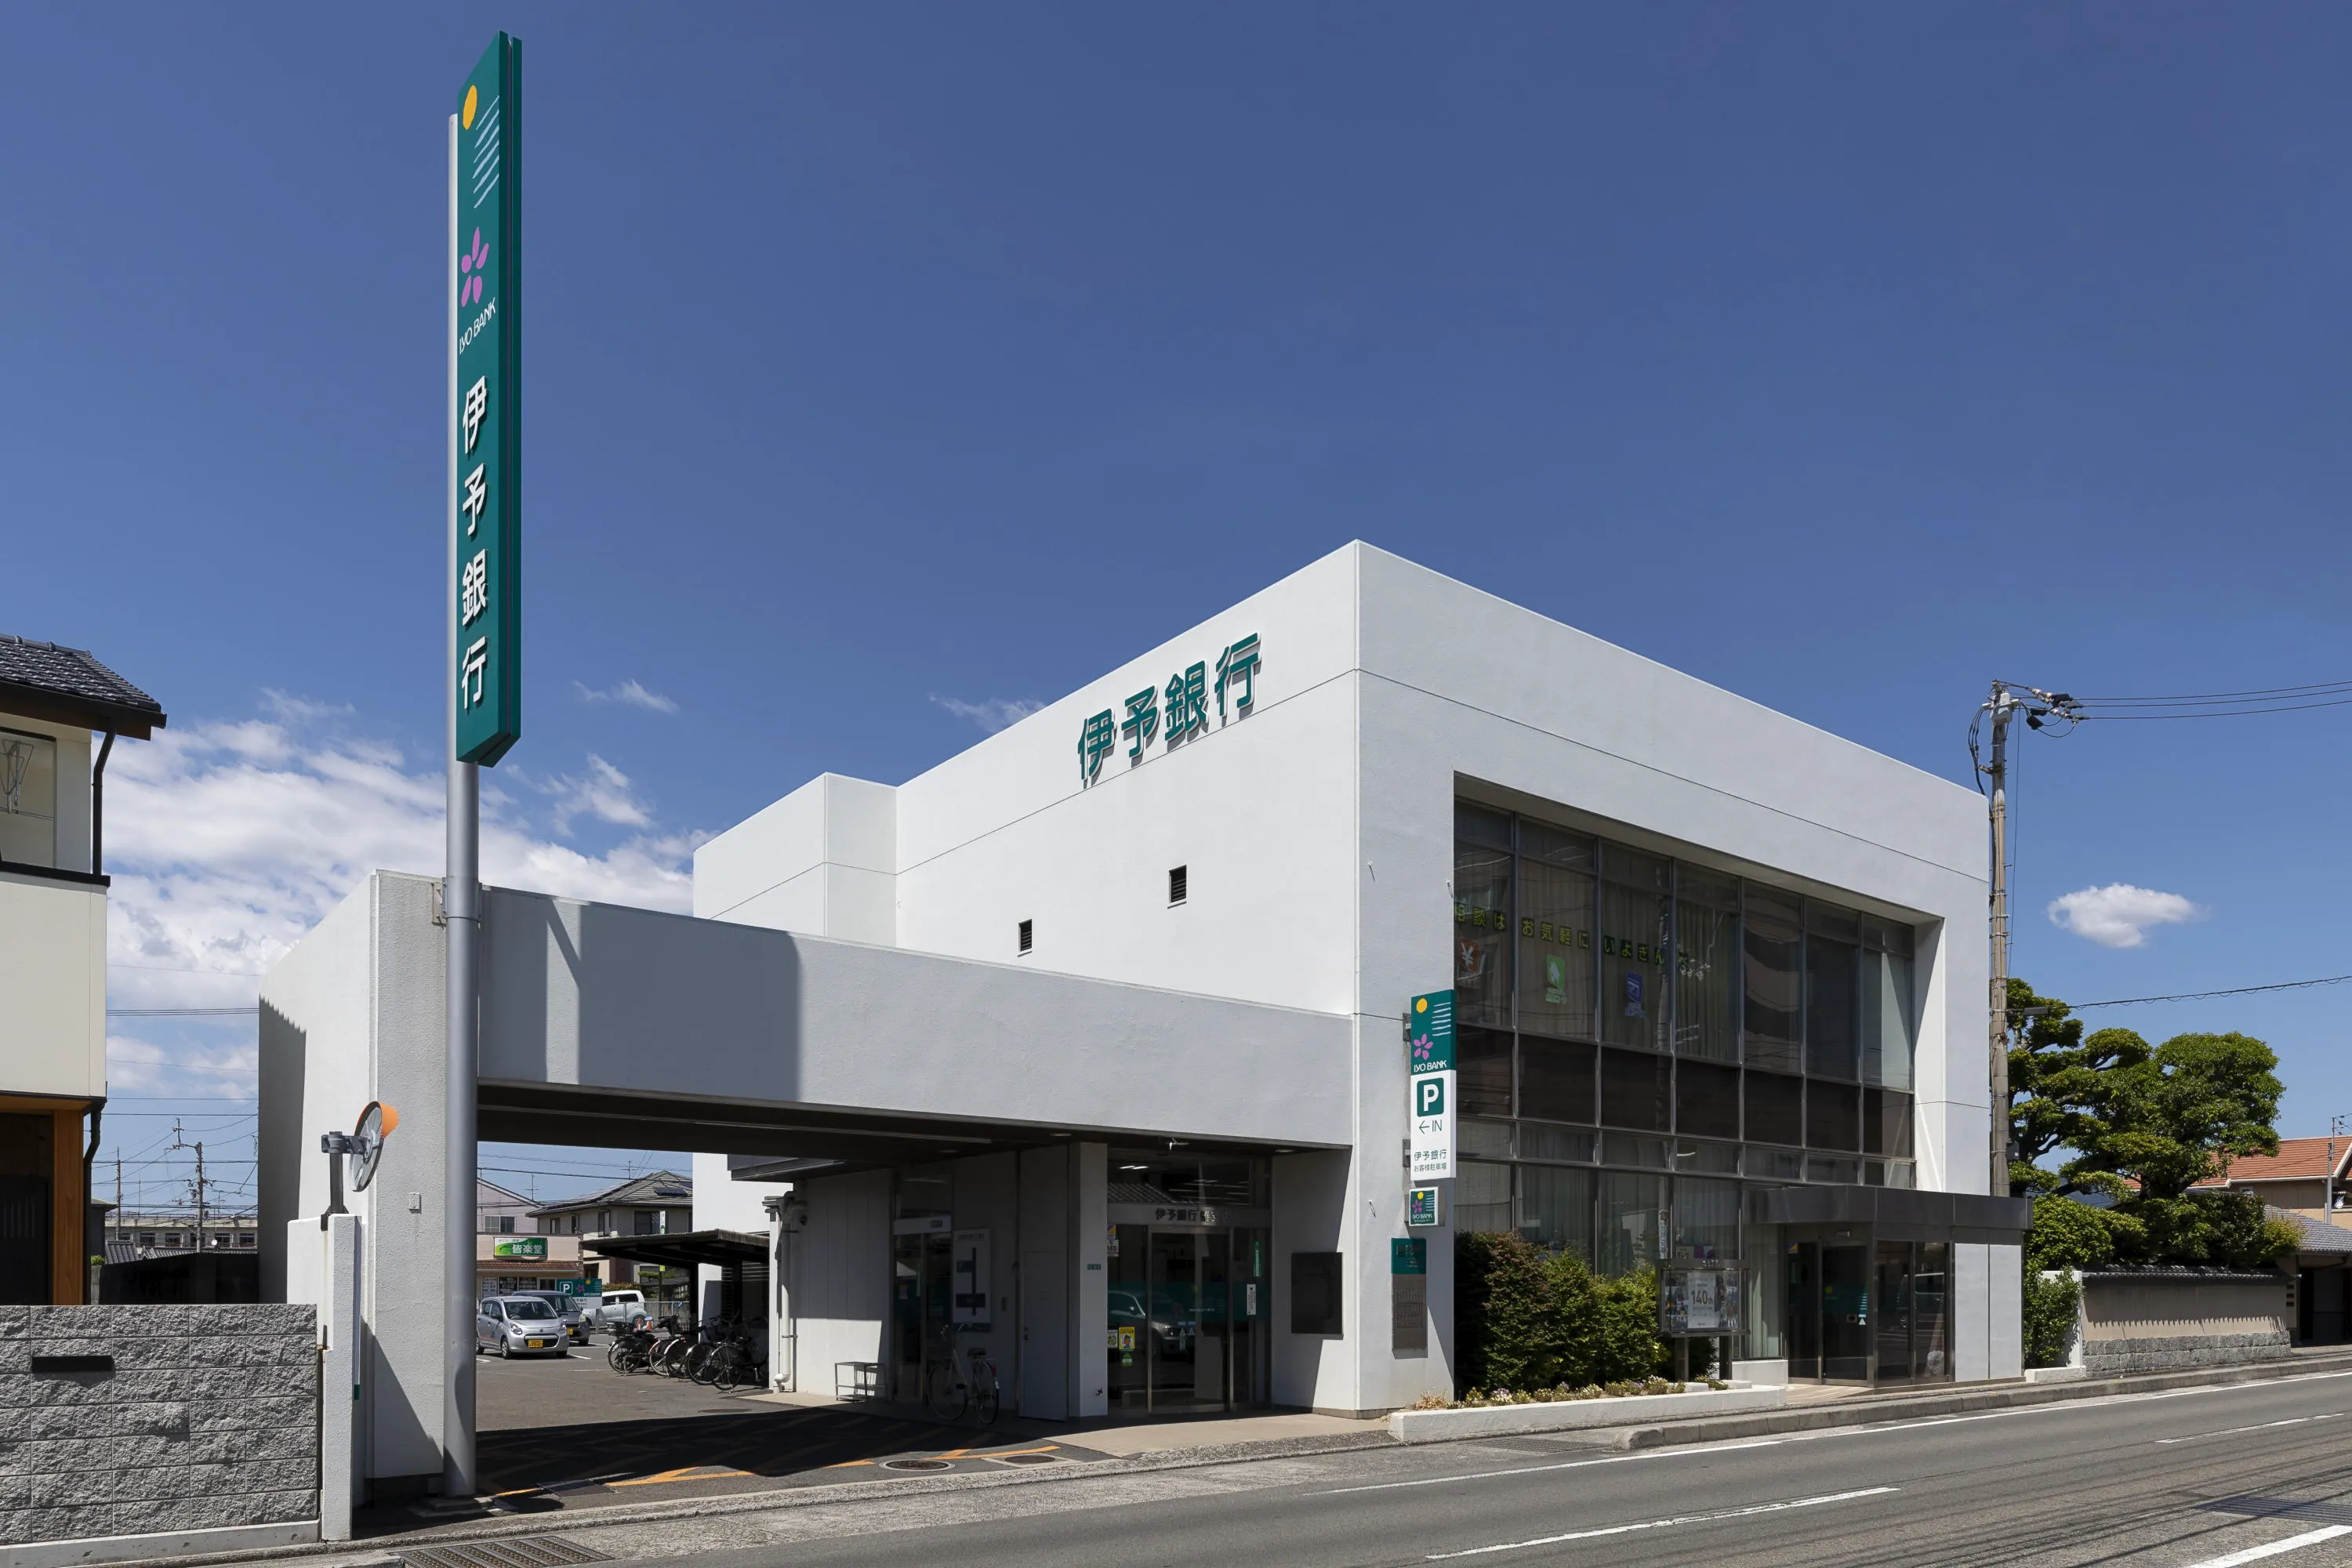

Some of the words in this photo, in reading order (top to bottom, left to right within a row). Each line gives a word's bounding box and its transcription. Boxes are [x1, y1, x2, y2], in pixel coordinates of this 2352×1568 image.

[459, 327, 473, 355] IYO
[474, 297, 495, 338] BANK
[461, 376, 488, 710] 伊予銀行
[1077, 632, 1261, 781] 伊予銀行
[1522, 919, 1589, 947] お気軽に
[1414, 1064, 1426, 1073] IYO
[1427, 1060, 1447, 1070] BANK
[1424, 1084, 1439, 1112] P
[1432, 1120, 1442, 1132] IN
[1414, 1149, 1447, 1161] 伊予銀行
[1414, 1163, 1447, 1172] お客様駐車場
[512, 1243, 543, 1254] 皆楽堂
[562, 1283, 570, 1293] P
